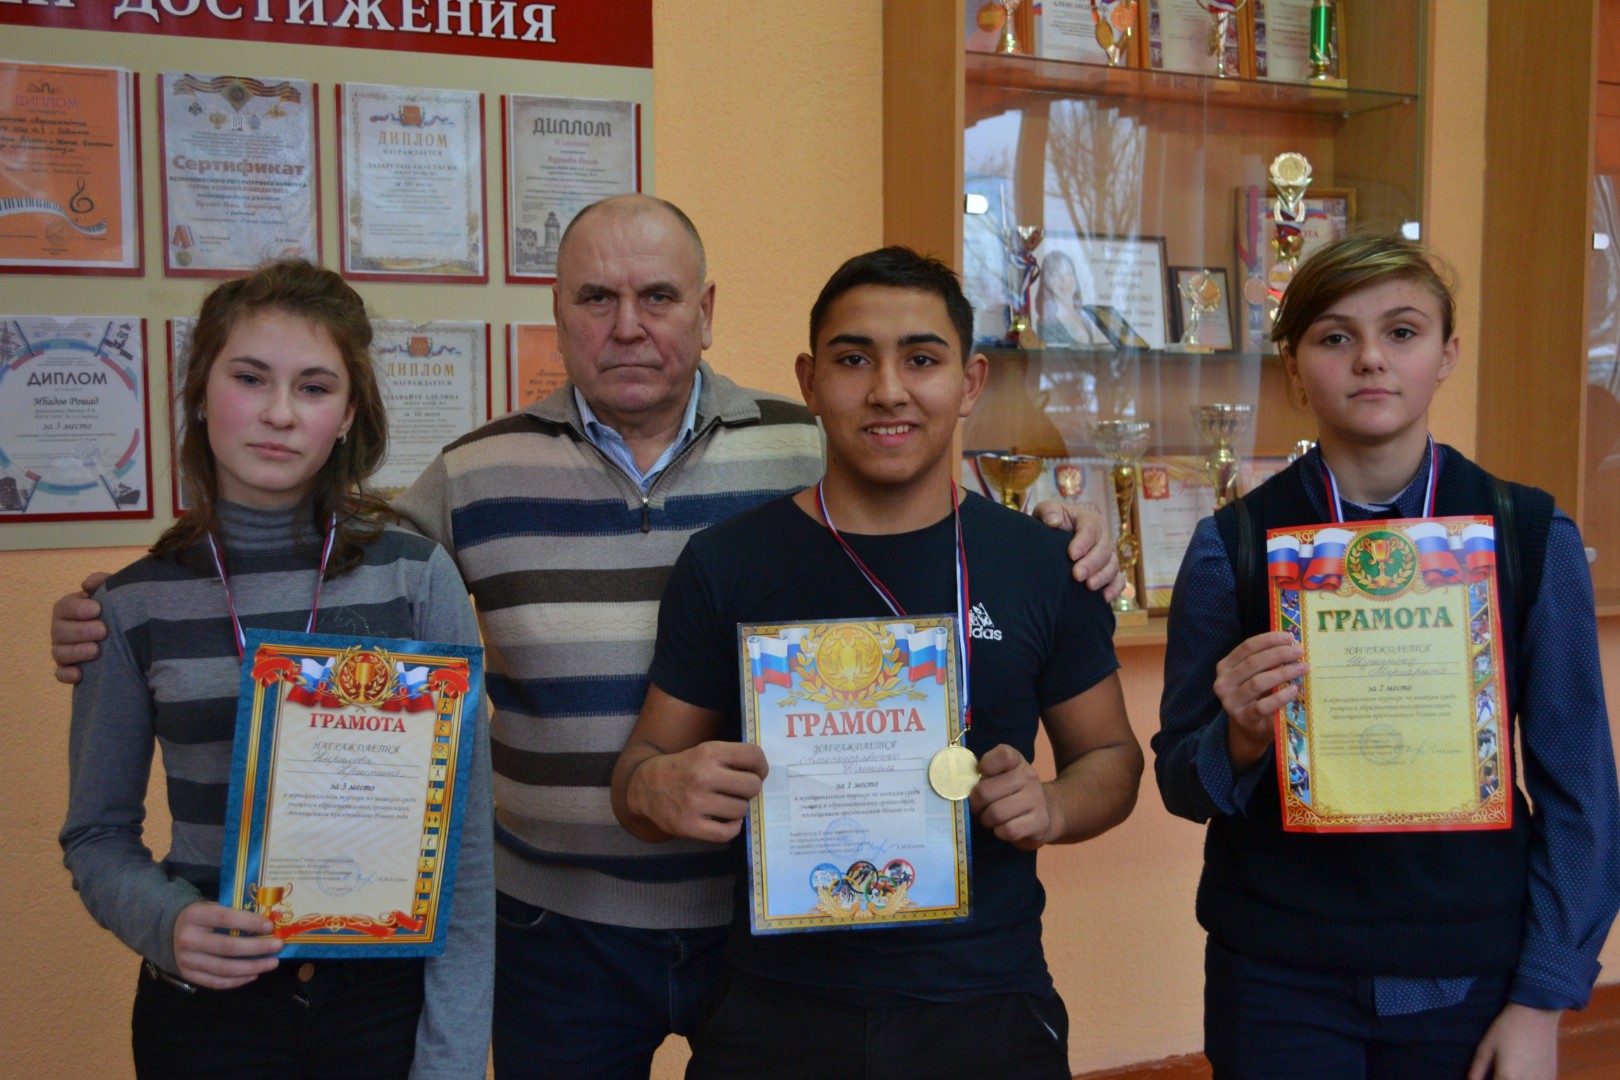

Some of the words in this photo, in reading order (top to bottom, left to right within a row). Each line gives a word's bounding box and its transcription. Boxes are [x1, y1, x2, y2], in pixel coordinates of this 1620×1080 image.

[533, 117, 612, 138] ДИПЛОМ
[378, 131, 448, 148] ДИПЛОМ
[172, 155, 305, 177] Сертификат
[386, 362, 455, 377] ДИПЛОМ
[27, 371, 107, 387] ДИПЛОМ
[56, 422, 61, 430] 3
[1316, 606, 1454, 632] ГРАМОТА
[969, 625, 1003, 641] idas
[1344, 643, 1432, 656] НАГРАЖДАЕТСЯ
[309, 712, 406, 733] ГРАМОТА
[785, 707, 926, 738] ГРАМОТА
[312, 742, 402, 754] НАГРАЖДАЕТСЯ
[814, 741, 898, 754] НАГРАЖДАЕТСЯ
[341, 782, 347, 790] 3
[348, 784, 376, 792] место
[854, 781, 878, 789] место
